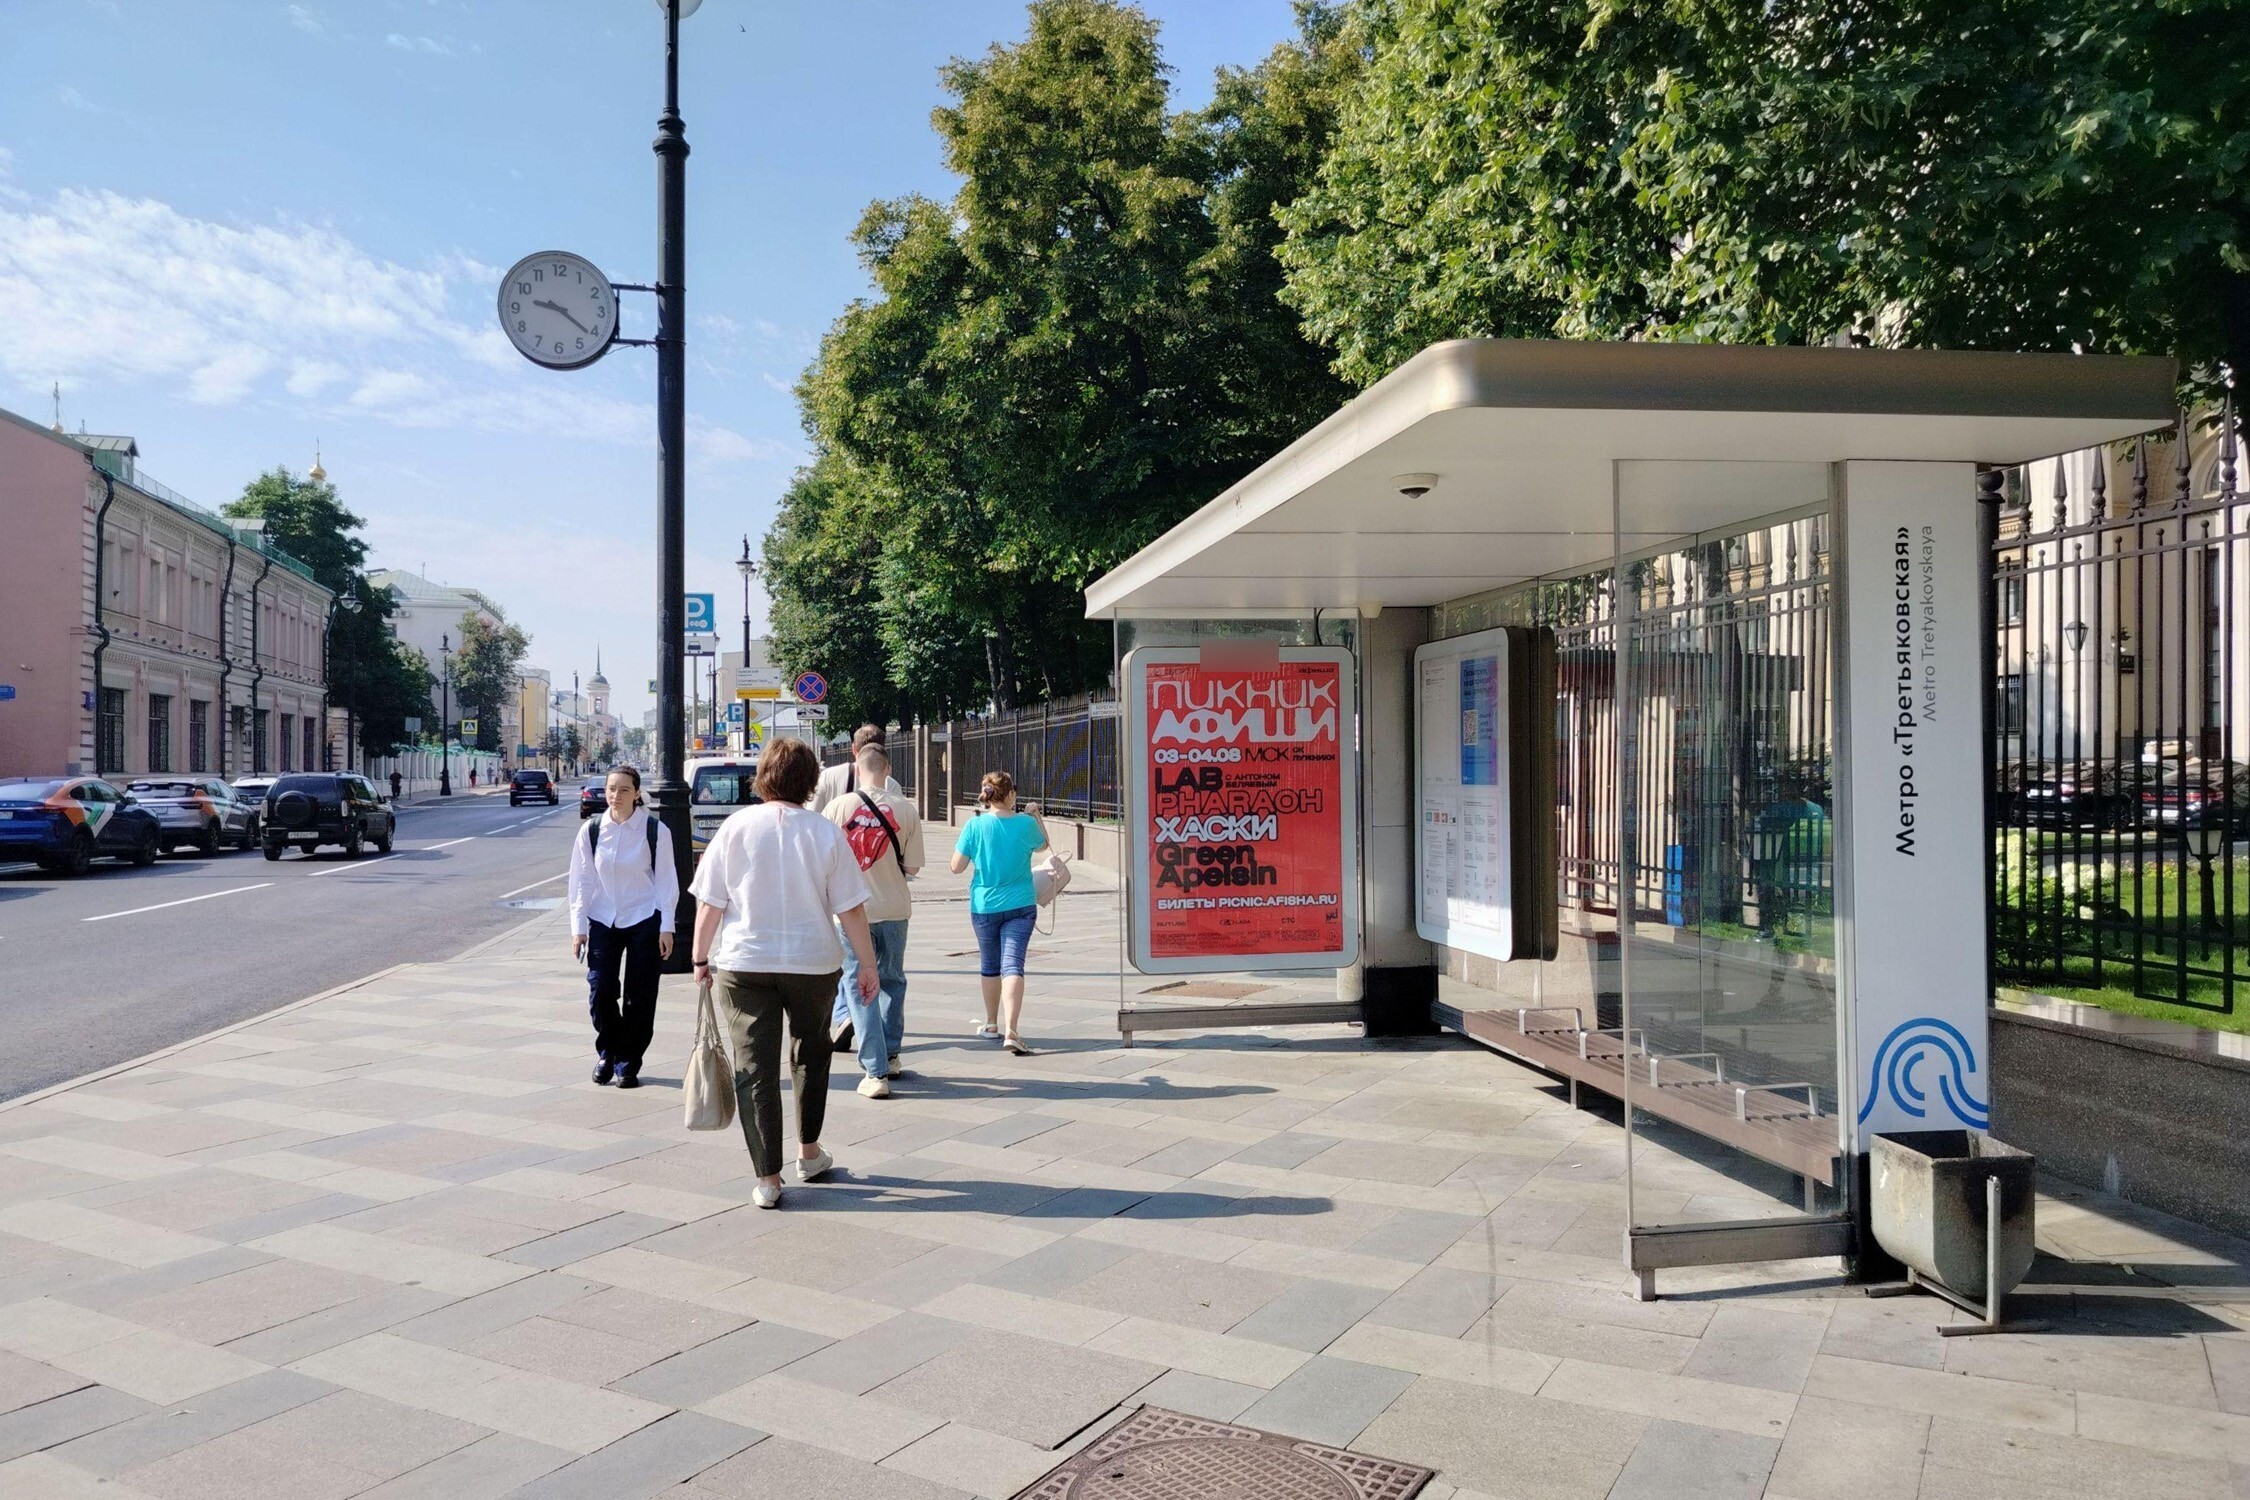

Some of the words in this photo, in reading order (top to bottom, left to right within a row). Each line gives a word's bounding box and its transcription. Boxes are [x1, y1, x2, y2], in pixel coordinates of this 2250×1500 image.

[533, 269, 543, 282] 11
[552, 264, 567, 277] 12
[576, 271, 582, 284] 1
[517, 282, 532, 295] 10
[590, 286, 599, 299] 2
[511, 302, 520, 314] 9
[597, 306, 605, 318] 3
[518, 320, 526, 333] 8
[590, 325, 599, 337] 4
[534, 335, 542, 347] 7
[575, 337, 584, 350] 5
[554, 342, 564, 354] 6
[1919, 525, 1937, 660] Tretyakovskaya
[1893, 526, 1917, 757] «Третьяковская»
[1921, 664, 1937, 722] Metro
[1151, 707, 1336, 744] АФИШИ
[1244, 747, 1289, 762] МСК
[1155, 767, 1224, 793] LAB
[1235, 773, 1281, 781] АНТОНОМ
[1156, 789, 1323, 815] PHARAOH
[1896, 764, 1918, 857] Метро
[1154, 814, 1279, 843] ХАСКИ
[1156, 843, 1255, 866] Green
[1156, 862, 1278, 893] Apelsin
[1157, 897, 1215, 910] БИЛЕТЫ
[1218, 894, 1337, 908] PICNIC.AFISHA.RU
